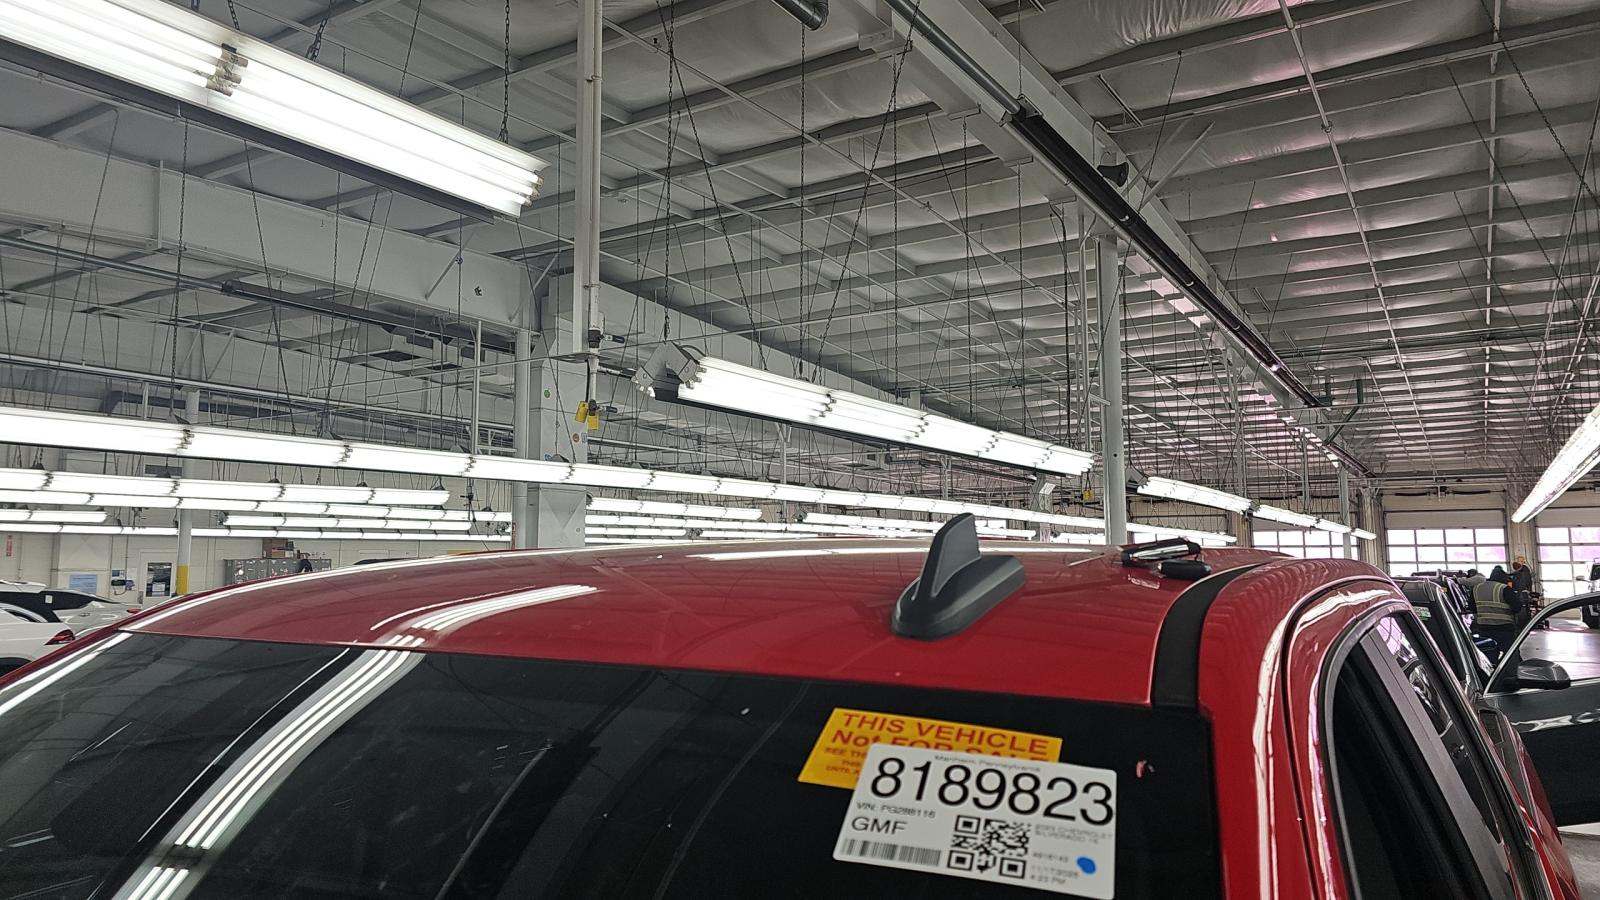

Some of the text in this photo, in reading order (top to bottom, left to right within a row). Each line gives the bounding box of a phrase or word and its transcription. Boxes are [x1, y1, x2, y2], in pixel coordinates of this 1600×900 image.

[843, 712, 905, 733] THIS
[917, 719, 1050, 756] VEHICLE
[871, 757, 1114, 827] 8189823
[851, 816, 908, 835] GMF
